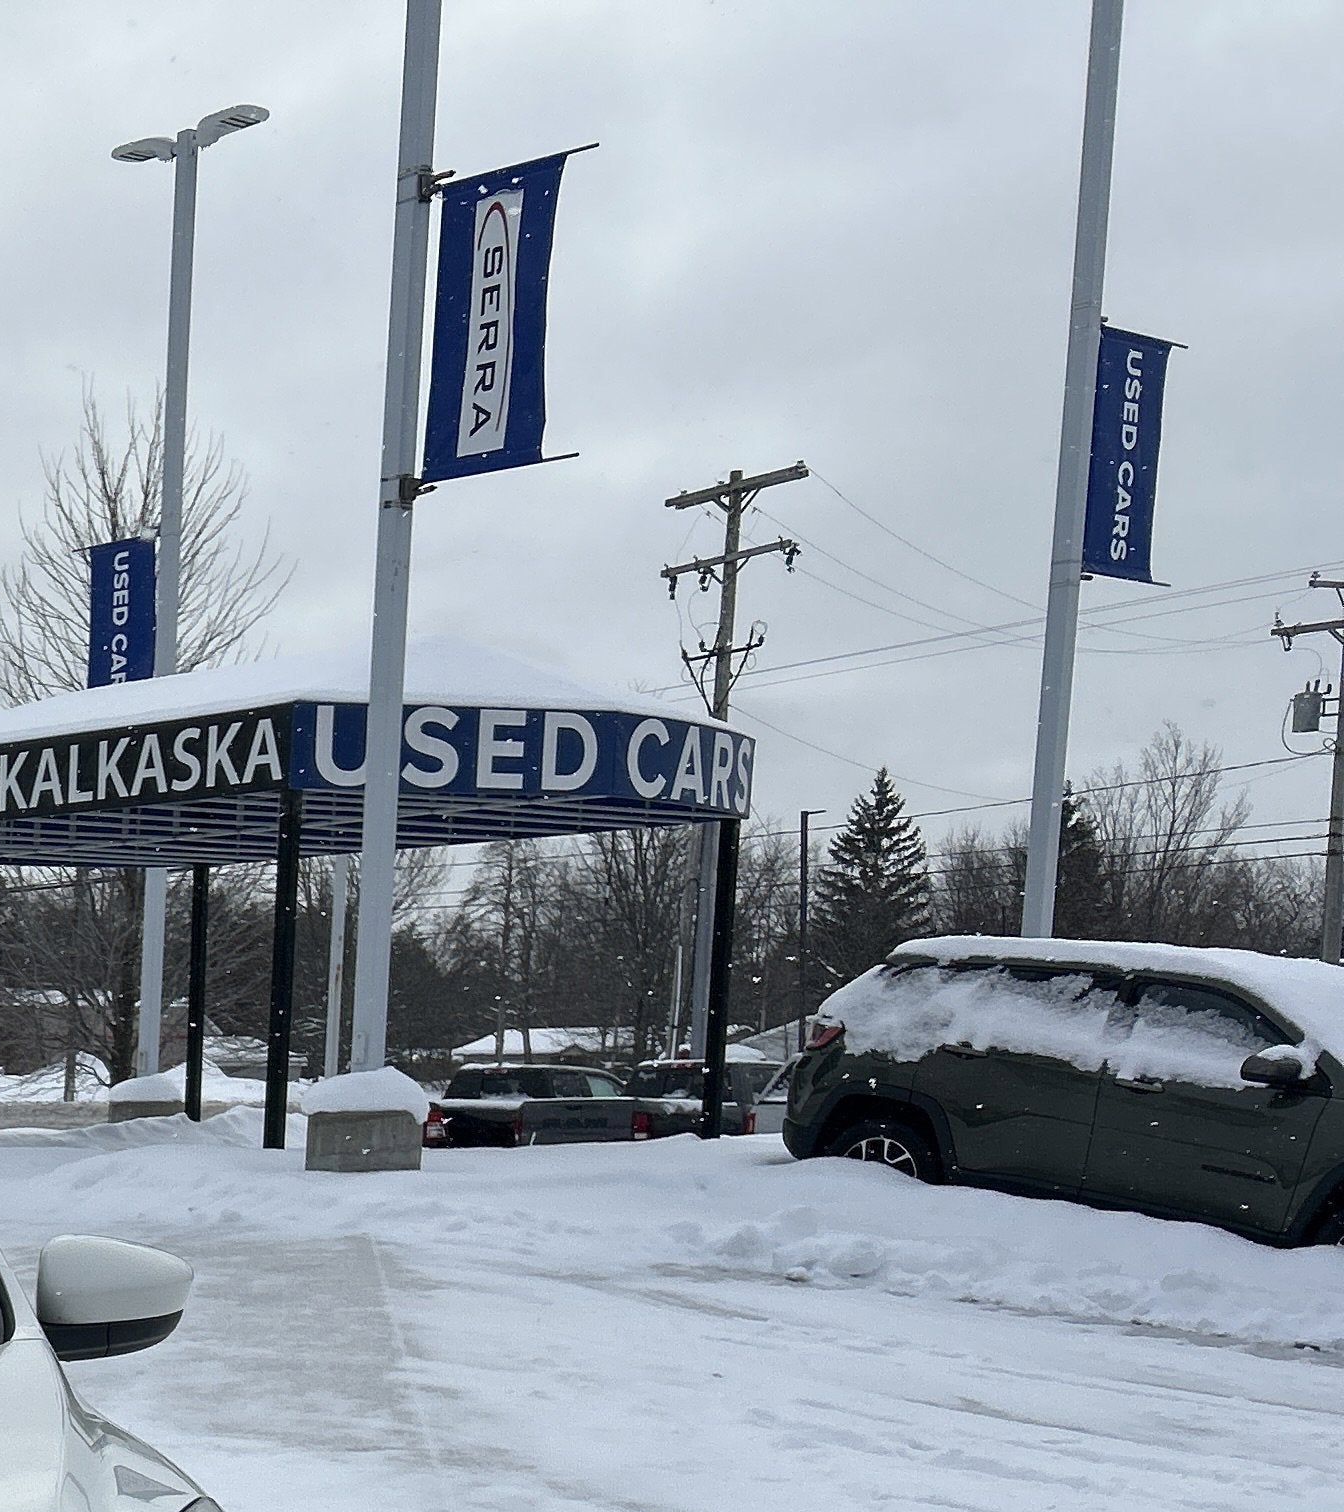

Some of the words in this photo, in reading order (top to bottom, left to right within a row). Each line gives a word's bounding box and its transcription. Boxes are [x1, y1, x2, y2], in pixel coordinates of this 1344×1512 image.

[469, 244, 504, 438] SERRA
[1121, 349, 1143, 451] USED
[1110, 461, 1135, 561] CARS
[113, 551, 130, 627] USED
[314, 704, 599, 791] USED
[626, 718, 754, 815] CARS
